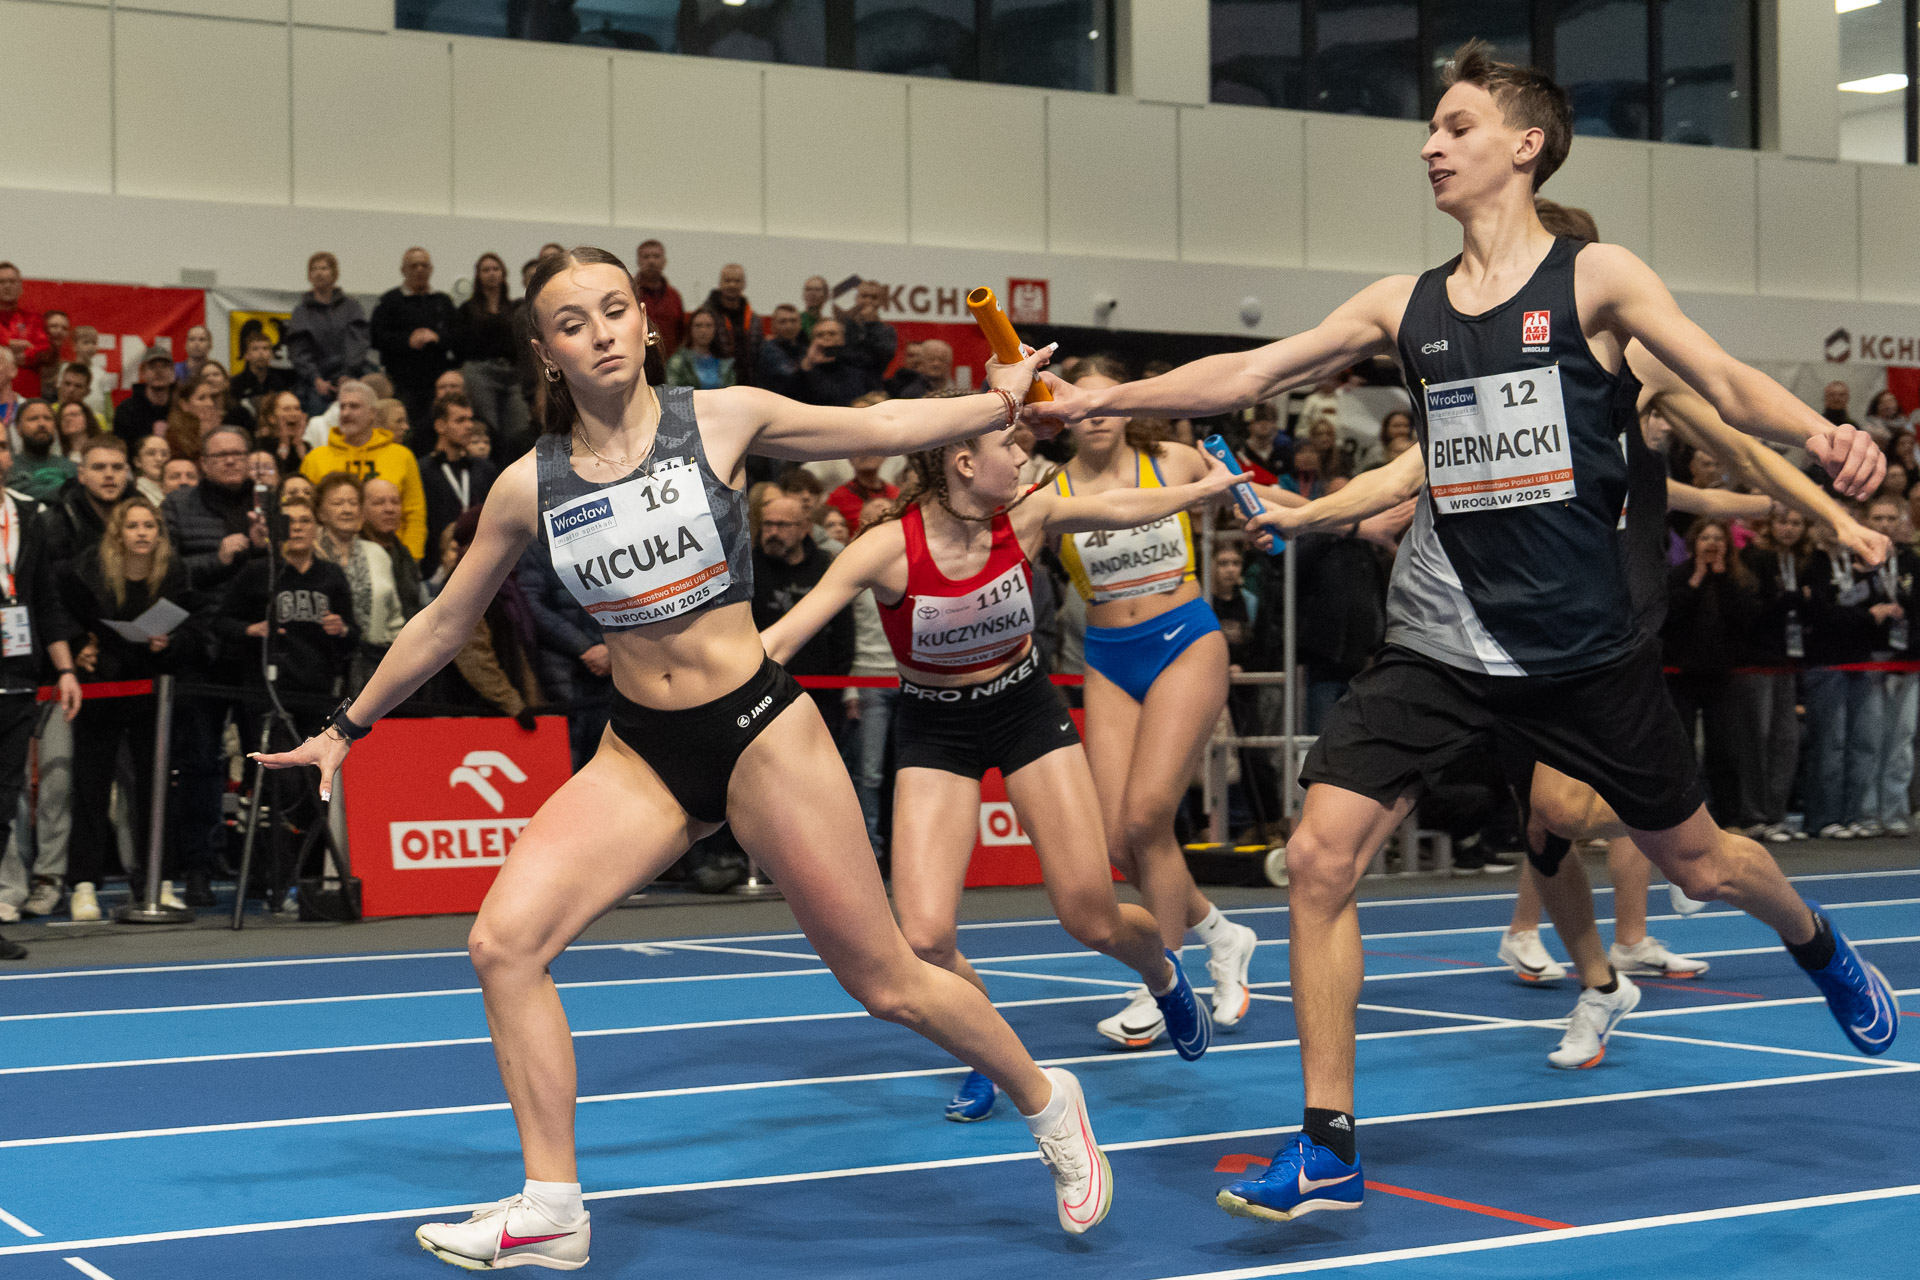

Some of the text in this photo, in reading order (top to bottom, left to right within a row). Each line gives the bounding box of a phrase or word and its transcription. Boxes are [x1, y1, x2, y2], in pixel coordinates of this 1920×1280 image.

[884, 284, 974, 316] KGH
[1525, 333, 1548, 341] AWF
[1860, 335, 1920, 360] KGH
[1429, 380, 1538, 408] Wrocław 12
[1434, 424, 1561, 468] BIERNACKI
[1511, 477, 1534, 486] Polski
[1535, 474, 1550, 483] U18
[1555, 471, 1570, 479] U20
[1516, 489, 1551, 502] 2025
[554, 479, 680, 532] Wrocław 16
[574, 525, 704, 590] KICUŁA
[1090, 539, 1183, 576] ANDRASZAK
[669, 581, 694, 594] Polski
[694, 574, 706, 586] U18
[710, 564, 725, 576] U20
[977, 573, 1025, 611] 1191
[611, 586, 711, 624] WROCŁAW 2025
[917, 607, 1031, 647] KUCZYŃSKA
[903, 682, 962, 702] PRO
[971, 659, 1033, 700] NIKE
[750, 695, 773, 719] JAKO
